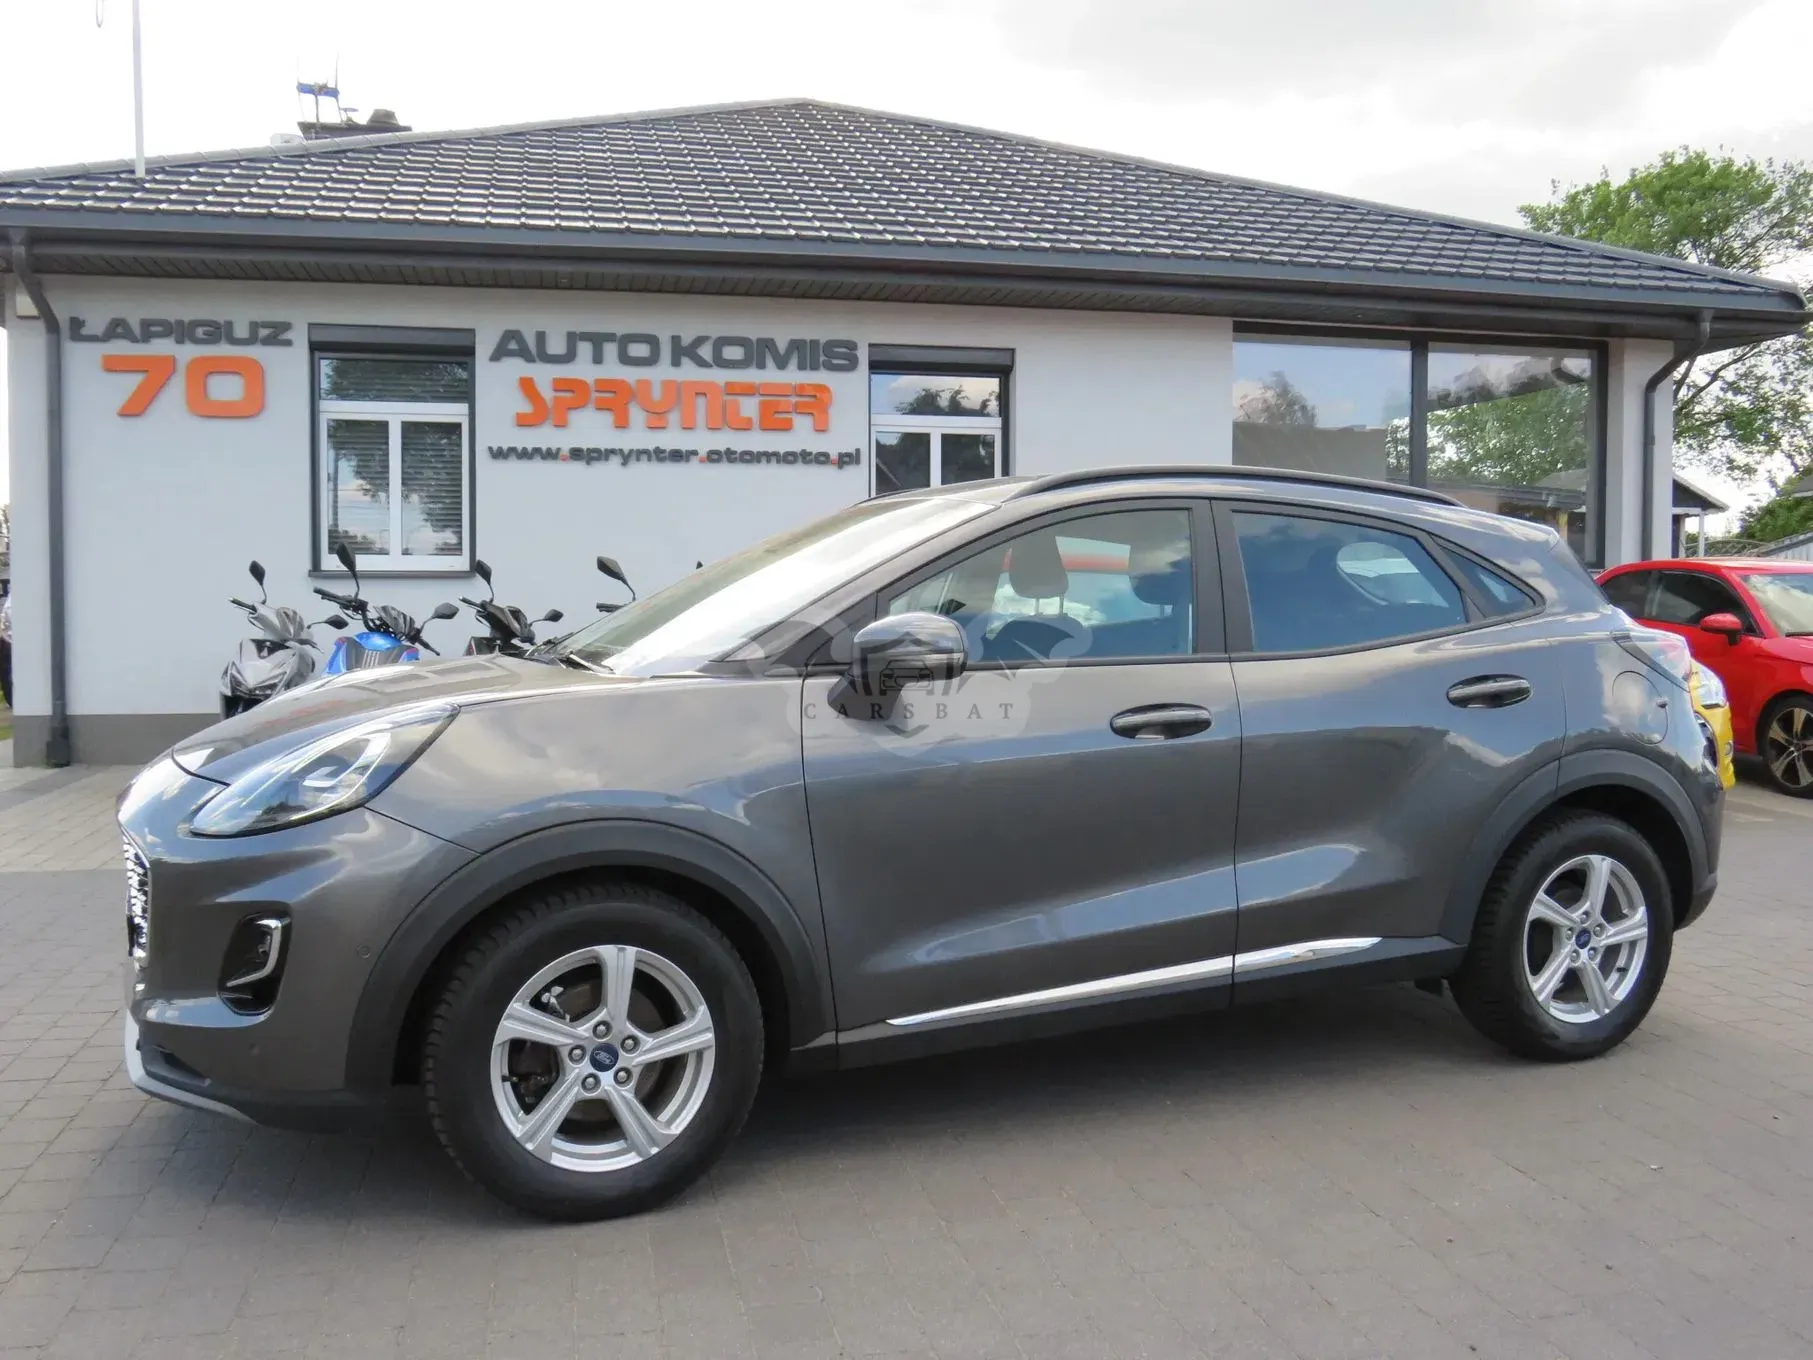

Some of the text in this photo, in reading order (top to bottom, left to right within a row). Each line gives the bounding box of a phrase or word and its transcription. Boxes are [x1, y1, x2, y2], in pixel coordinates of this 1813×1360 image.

[69, 316, 294, 347] ŁAPIGUZ
[488, 328, 860, 372] AUTO KOMIS
[101, 354, 266, 420] 70
[515, 376, 834, 432] SPRYNTER
[488, 444, 862, 470] www.sprynter.otomoto.pl
